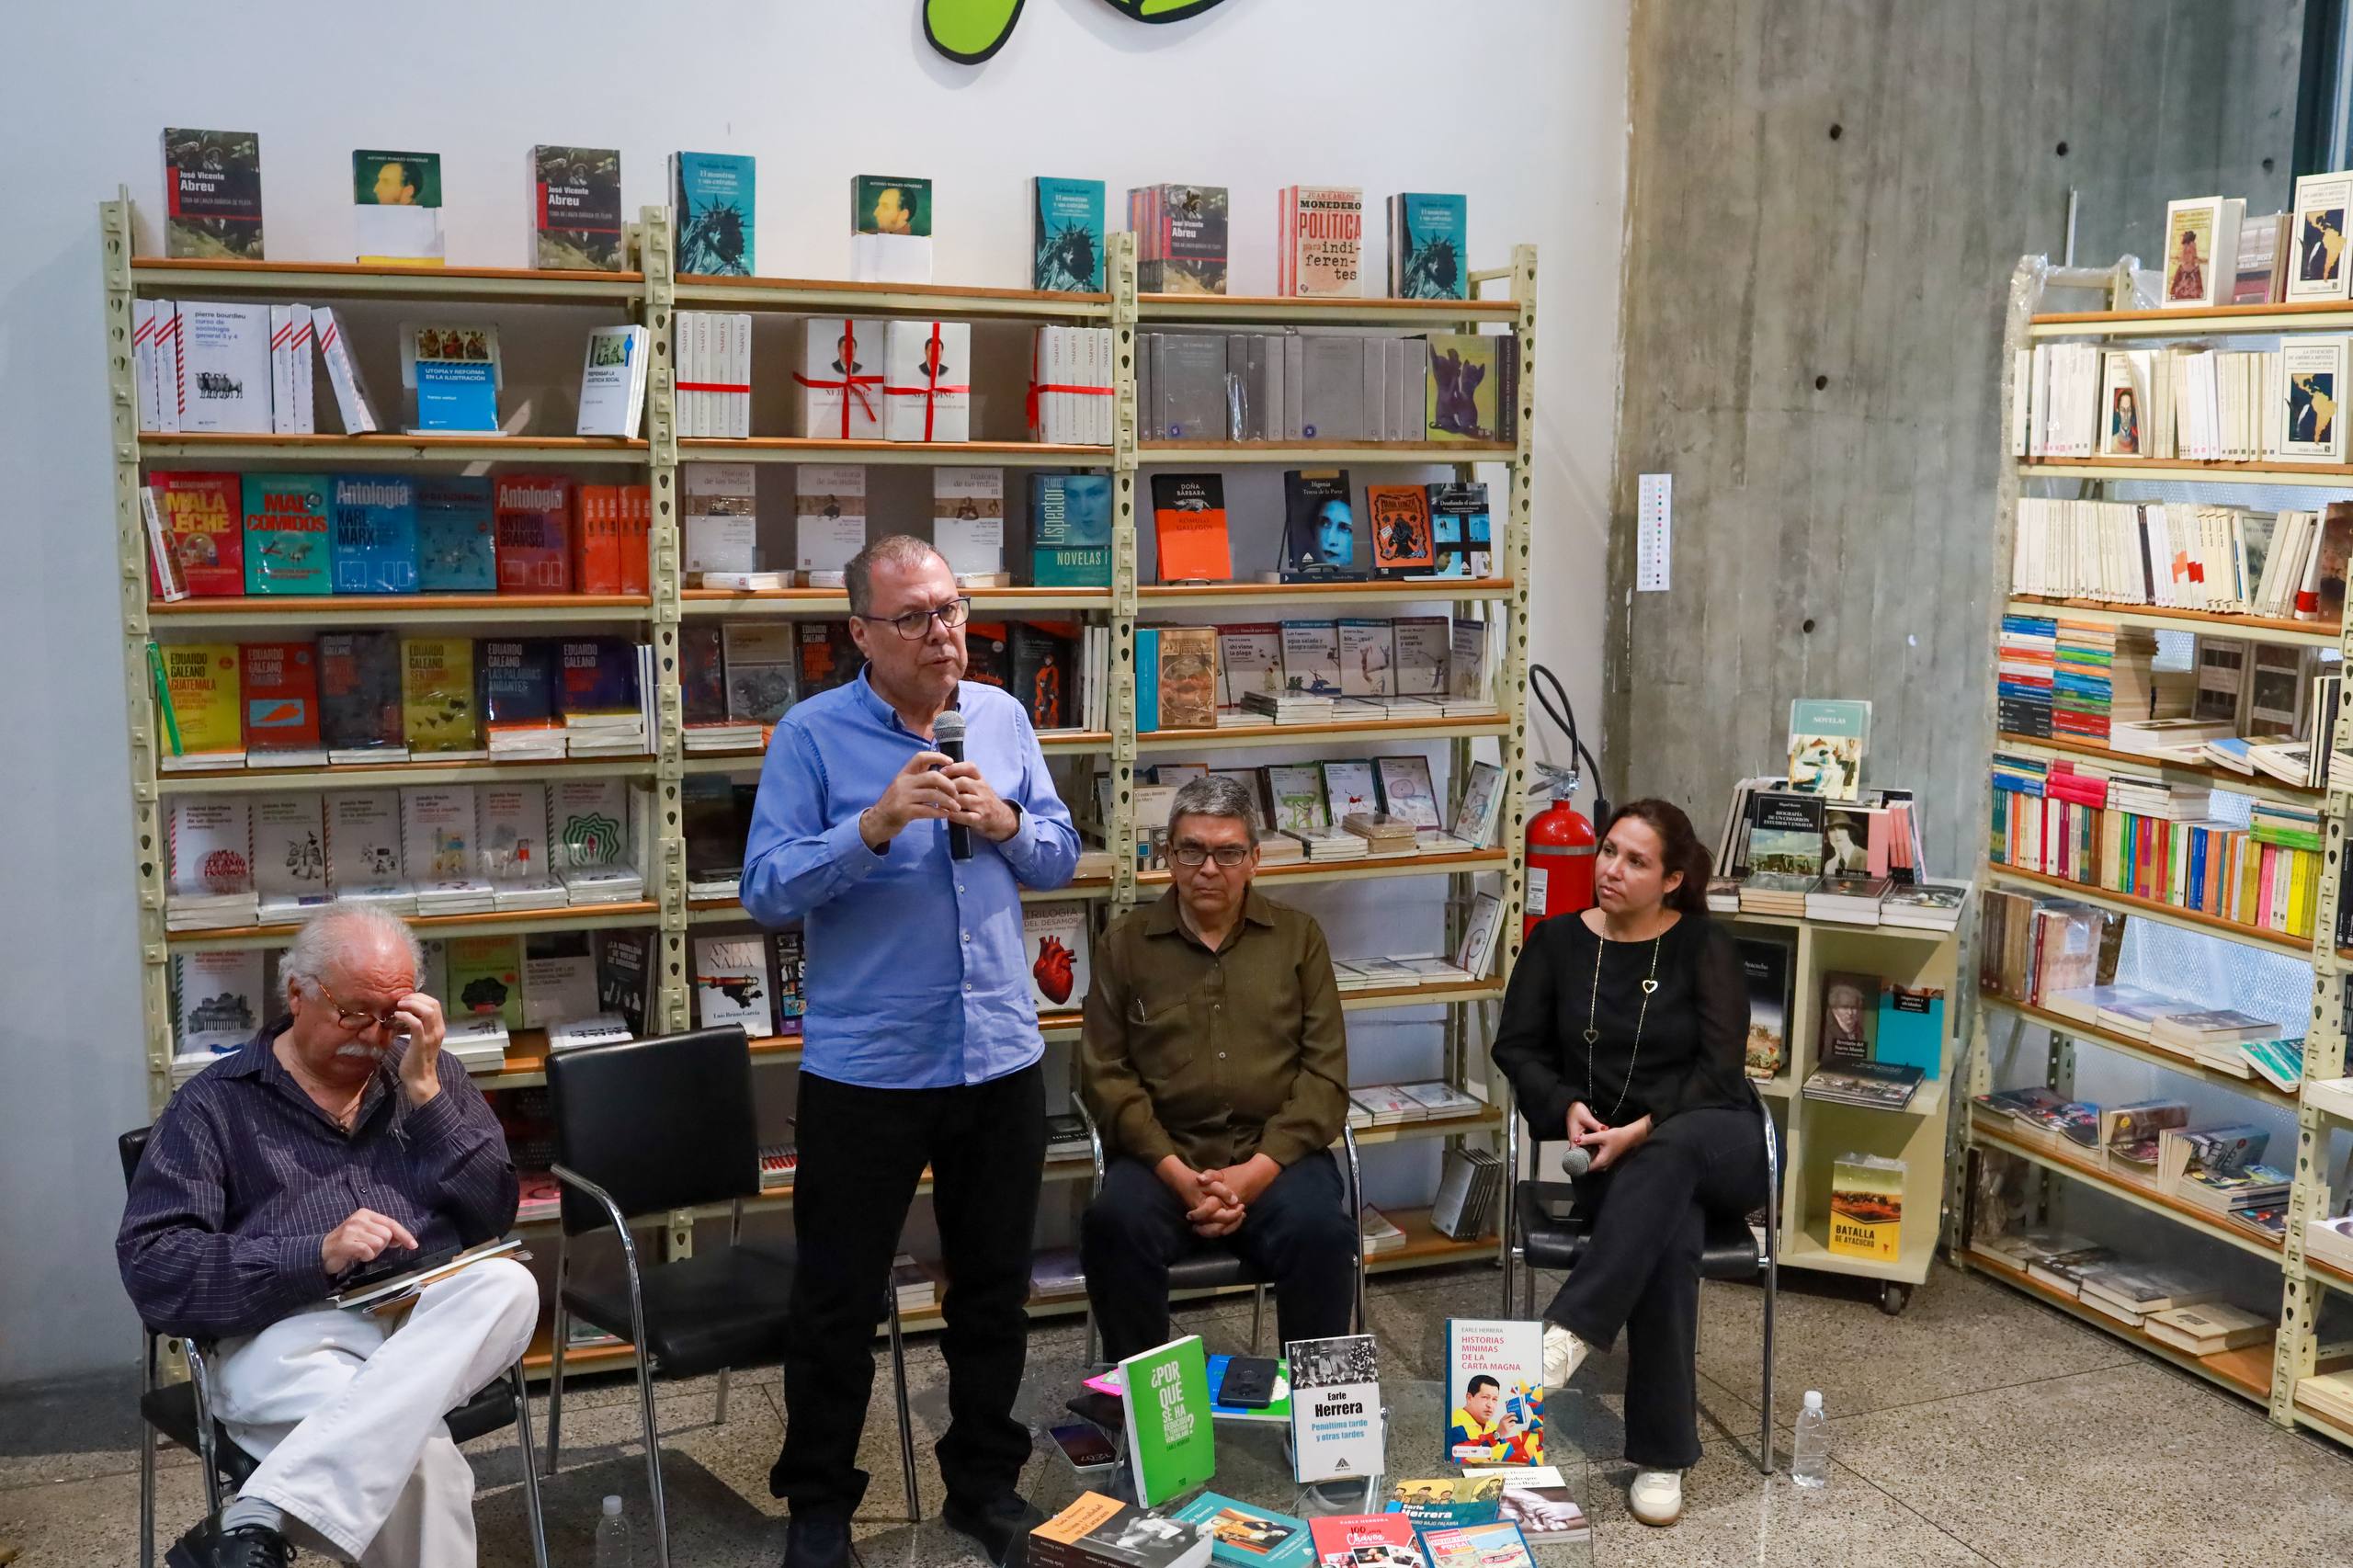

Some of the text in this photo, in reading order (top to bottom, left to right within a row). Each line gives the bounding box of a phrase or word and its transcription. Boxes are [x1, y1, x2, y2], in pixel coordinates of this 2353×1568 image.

[197, 172, 224, 180] Vicente
[180, 179, 215, 192] Abreu
[563, 187, 589, 195] Vicente
[548, 194, 580, 206] Abreu
[1328, 191, 1355, 200] CARLOS
[1300, 199, 1361, 210] MONEDERO
[1300, 210, 1362, 240] POLÍTICA
[1172, 227, 1197, 238] Abreu
[1303, 241, 1361, 254] para indi-
[1306, 254, 1356, 267] feren-
[1335, 268, 1357, 280] tes
[336, 480, 409, 509] Antología
[499, 483, 563, 513] Antología
[1177, 488, 1206, 496] BÁRBARA
[165, 492, 229, 514] MALA
[265, 494, 309, 514] MAL
[337, 508, 369, 527] KARL
[499, 514, 544, 531] ANTONIO
[1037, 488, 1072, 544] Lispector
[246, 514, 328, 533] COMIDOS
[338, 528, 375, 545] MARX
[500, 530, 545, 548] GRAMSCI
[1057, 551, 1101, 566] NOVELAS
[802, 624, 827, 634] EDUARDO
[802, 634, 826, 643] GALEANO
[248, 648, 284, 661] EDUARDO
[409, 645, 444, 657] EDUARDO
[488, 644, 523, 656] EDUARDO
[563, 643, 597, 656] EDUARDO
[170, 653, 208, 665] EDUARDO
[410, 657, 443, 669] GALEANO
[488, 656, 520, 668] GALEANO
[564, 656, 597, 668] GALEANO
[170, 666, 206, 678] GALEANO
[249, 661, 283, 674] GALEANO
[1024, 907, 1078, 920] TRILOGÍA
[1041, 917, 1078, 926] DESAMOR
[709, 955, 754, 971] NADA
[1836, 1224, 1875, 1240] BATALLA
[1844, 1236, 1875, 1248] AYACUCHO
[1461, 1336, 1505, 1345] HISTORIAS
[1461, 1344, 1499, 1353] MÍNIMAS
[1151, 1360, 1181, 1389] ¿POR
[1159, 1379, 1185, 1411] QUÉ
[1327, 1392, 1347, 1401] Earle
[1162, 1403, 1187, 1424] SE HA
[1315, 1402, 1363, 1417] Herrera
[1312, 1418, 1368, 1432] Penúltima tarde
[1322, 1433, 1340, 1441] otras
[1341, 1430, 1365, 1439] tardes
[1166, 1437, 1190, 1452] EARLE HERRERA
[1402, 1510, 1452, 1518] Herrera
[1350, 1527, 1367, 1535] 100
